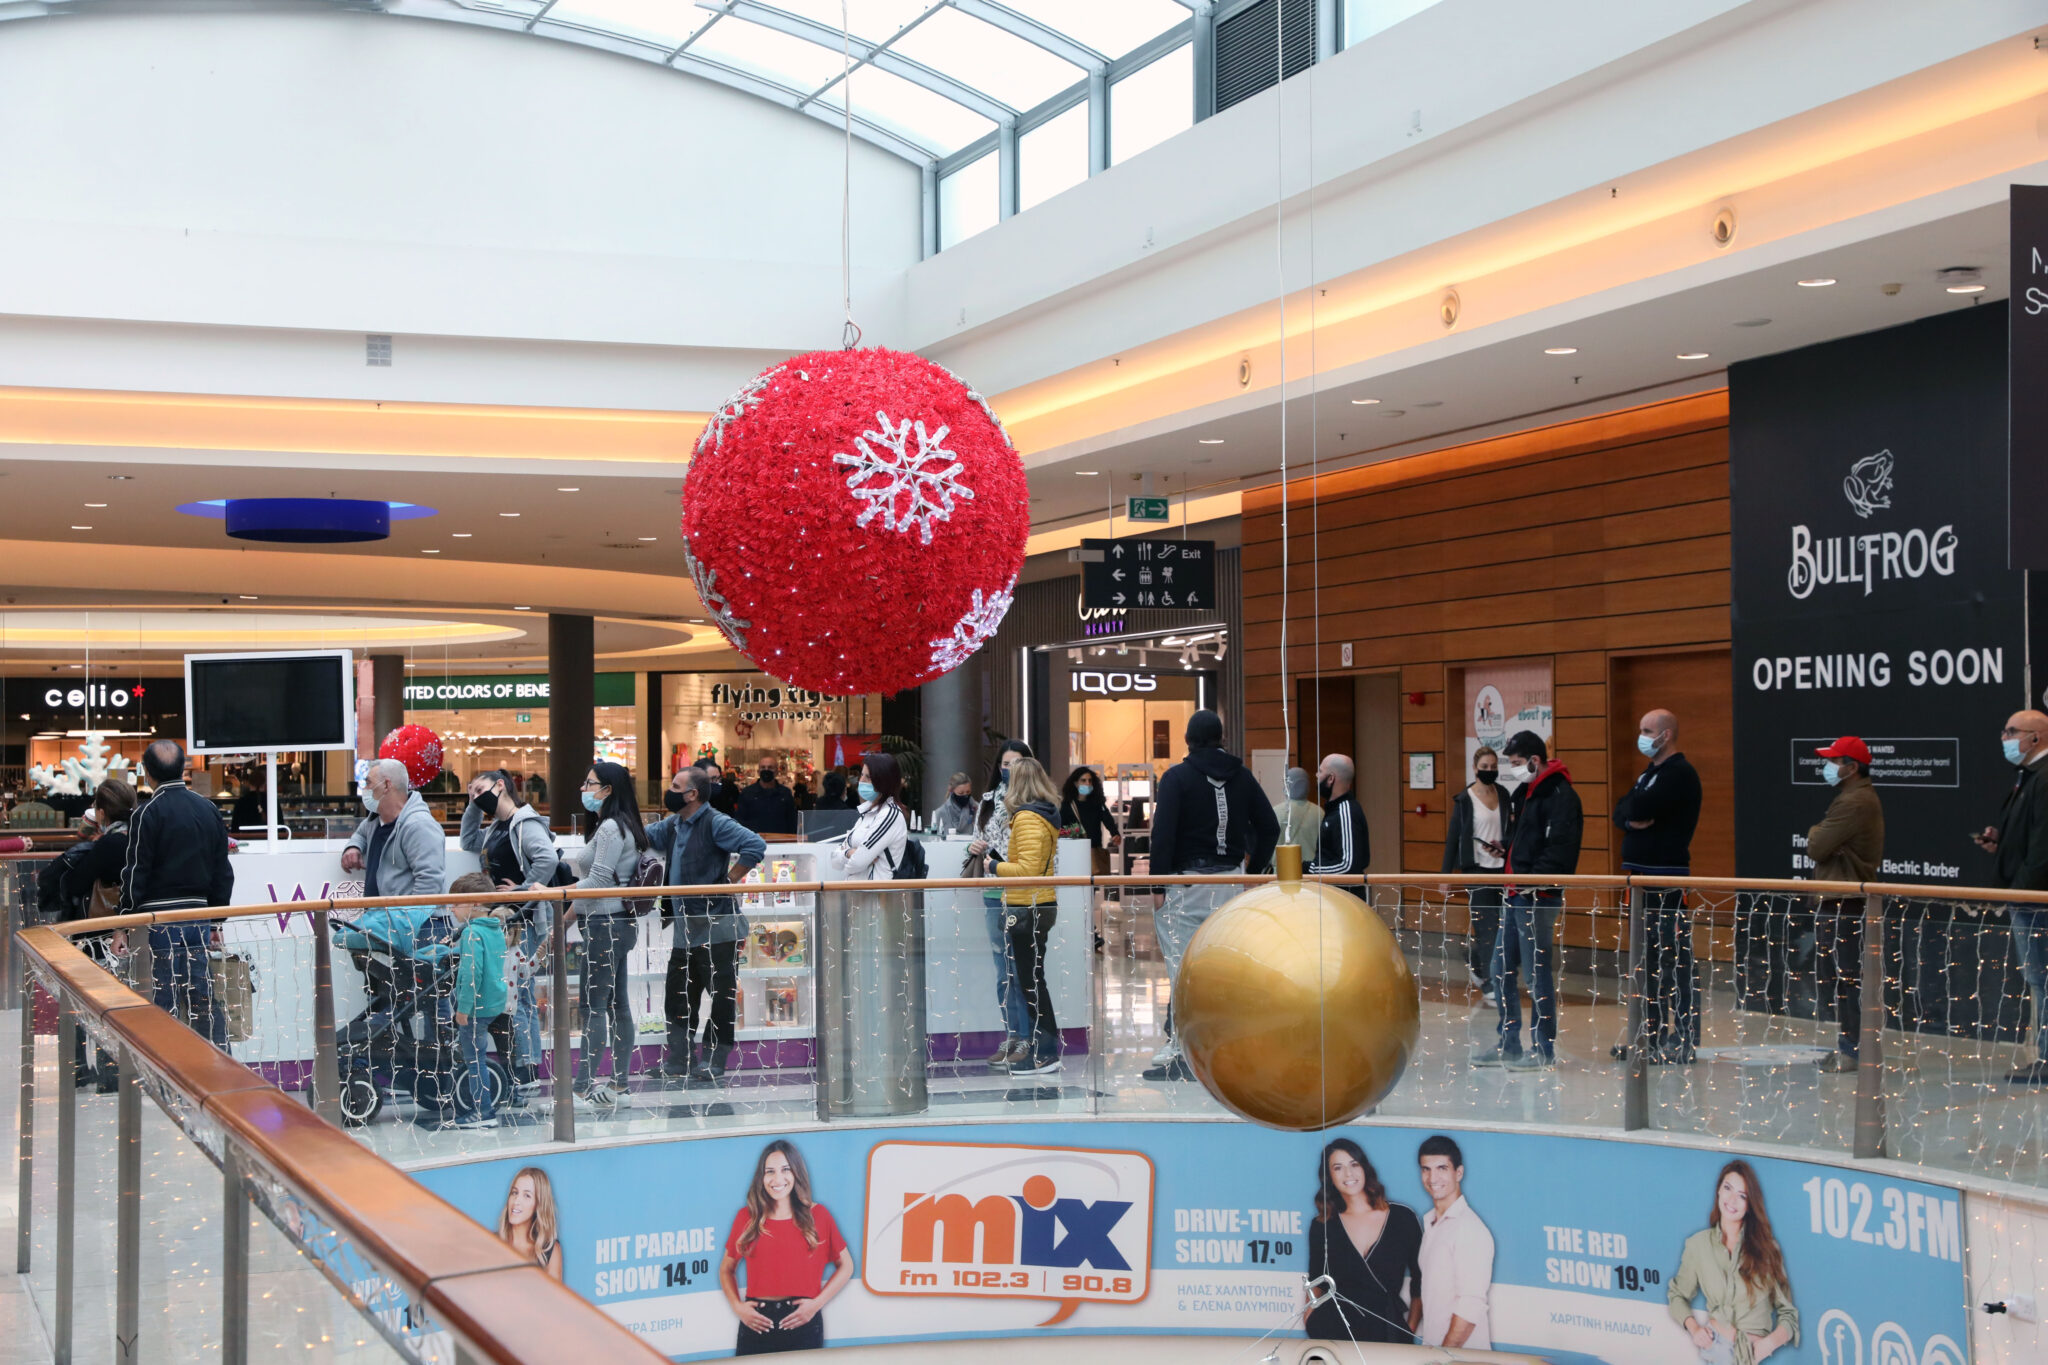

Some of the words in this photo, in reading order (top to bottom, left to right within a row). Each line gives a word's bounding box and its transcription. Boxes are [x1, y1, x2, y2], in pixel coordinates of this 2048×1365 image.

[1182, 549, 1201, 559] Exit
[1788, 525, 1958, 599] BULLFROG
[1085, 620, 1124, 635] BEAUTY
[1753, 652, 1891, 690] OPENING
[1908, 647, 2003, 686] SOON
[45, 684, 129, 707] celio
[403, 685, 434, 700] ITED
[436, 684, 492, 699] COLORS
[493, 683, 514, 698] OF
[515, 683, 550, 697] BENE
[711, 683, 780, 708] flying
[1072, 672, 1157, 695] IQOS
[739, 710, 822, 721] copenhagen
[1541, 710, 1552, 727] pe
[1885, 758, 1906, 766] wanted
[1882, 859, 1921, 875] Electric
[1923, 862, 1960, 878] Barber
[900, 1174, 1134, 1272] mix
[1174, 1208, 1303, 1235] DRIVE-TIME
[1802, 1176, 1961, 1263] 102.3FM
[595, 1235, 631, 1265] HIT
[634, 1226, 716, 1260] PARADE
[1175, 1238, 1245, 1264] SHOW
[1543, 1225, 1585, 1254] THE
[1587, 1230, 1628, 1259] RED
[594, 1264, 661, 1297] SHOW
[899, 1269, 938, 1286] fm
[952, 1270, 1030, 1288] 102.3
[1062, 1274, 1133, 1293] 90.8
[1545, 1257, 1612, 1290] SHOW
[1177, 1284, 1213, 1297] ΗΛΙΑΣ
[1215, 1284, 1294, 1299] ΧΑΛΝΤΟΥΠΗΣ
[1178, 1300, 1187, 1312] &
[1192, 1300, 1232, 1313] ΕΛΕΝΑ
[1234, 1301, 1296, 1314] ΟΛΥΜΠΙΟΥ
[650, 1317, 683, 1333] ΣΙΒΡΗ
[1549, 1311, 1602, 1331] ΧΑΡΙΤΙΝΗ
[1603, 1320, 1653, 1337] ΗΛΙΑΔΟΥ
